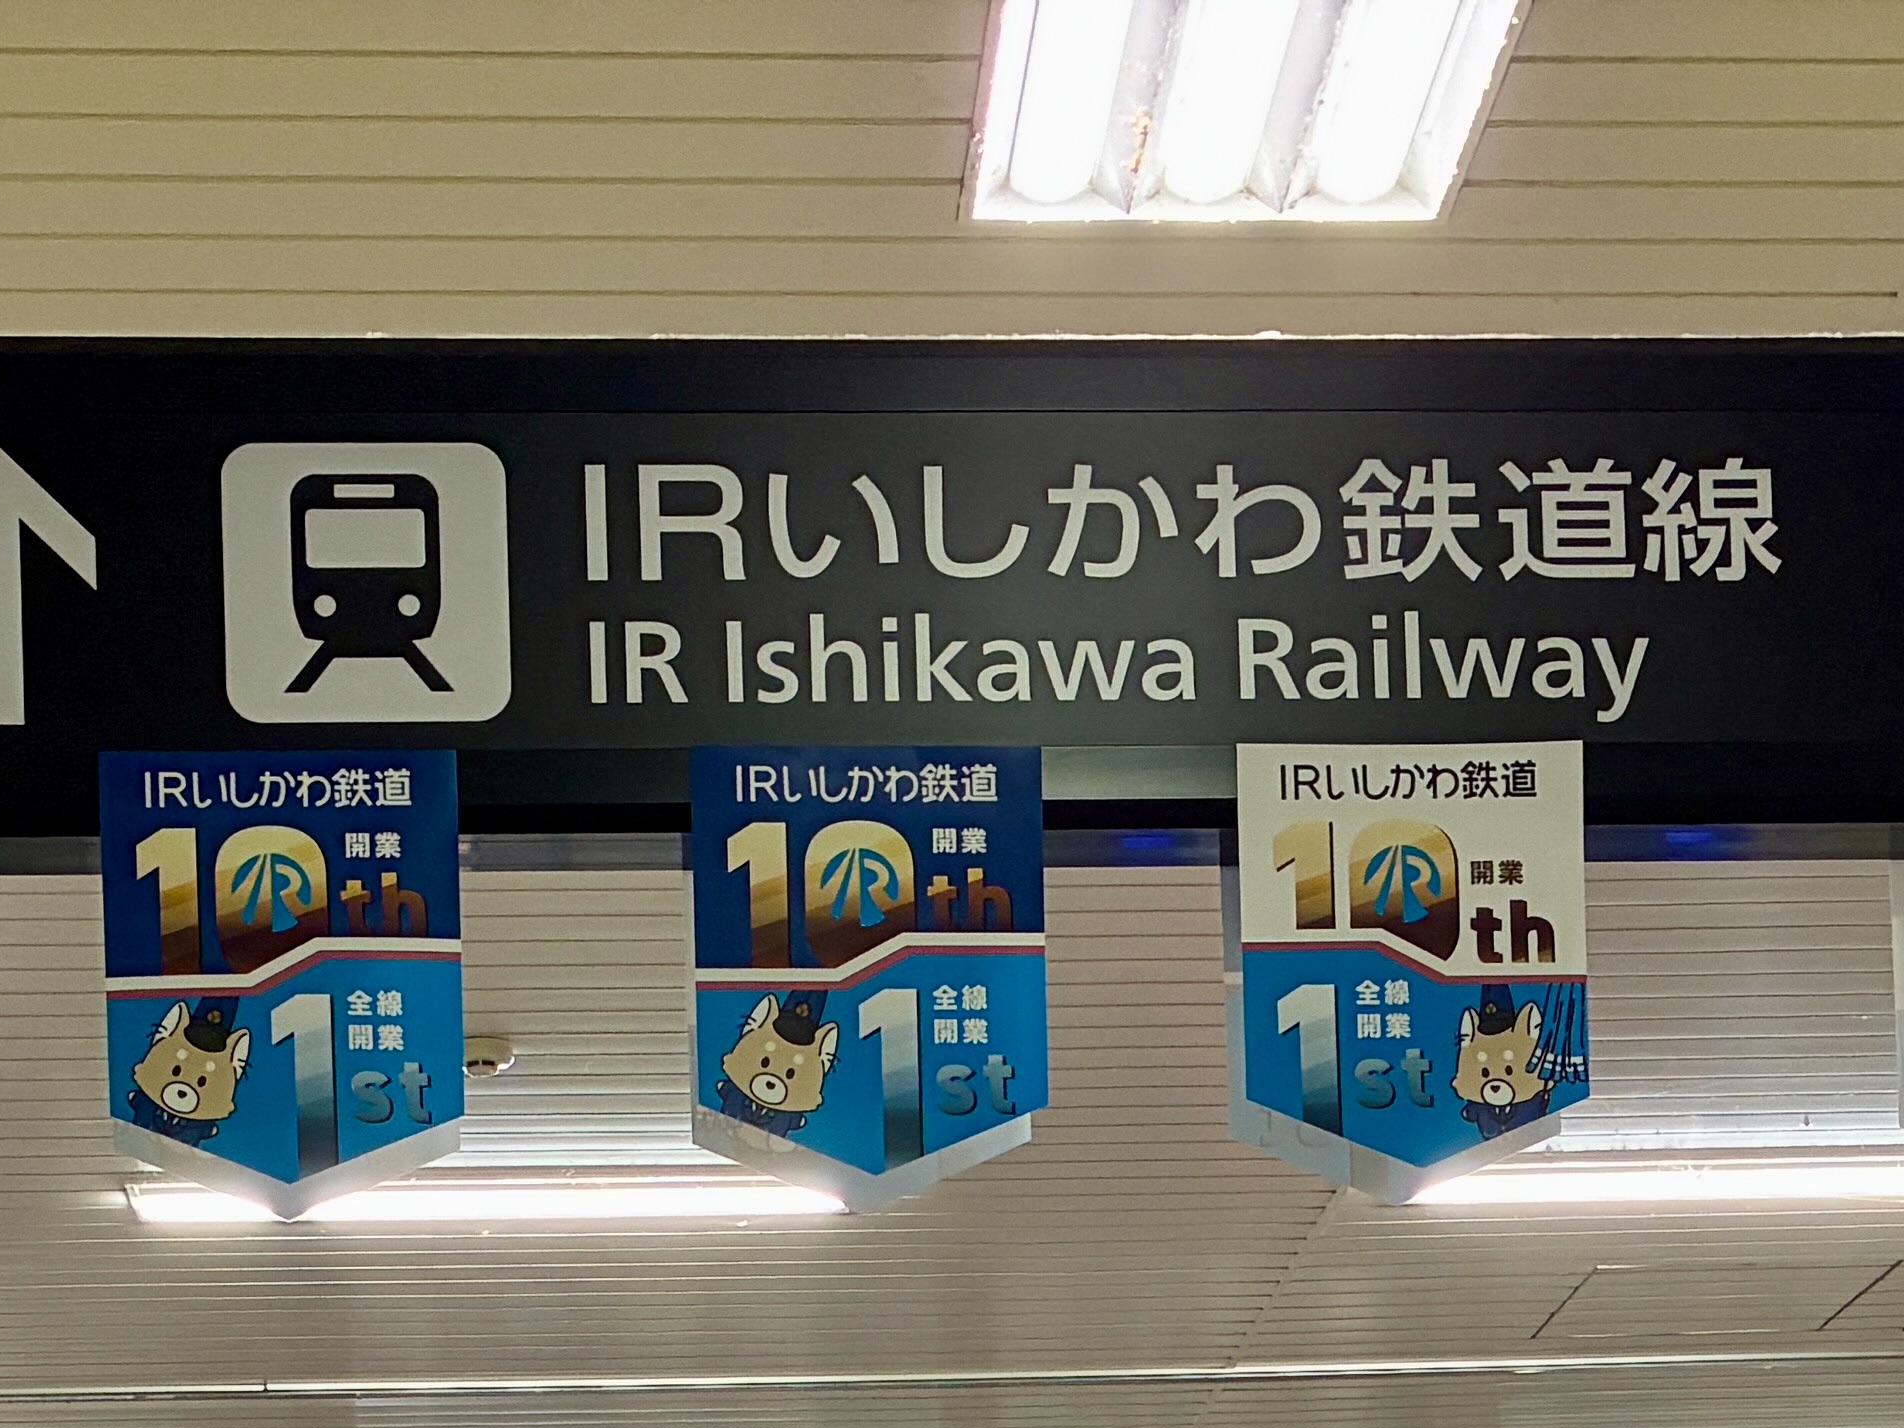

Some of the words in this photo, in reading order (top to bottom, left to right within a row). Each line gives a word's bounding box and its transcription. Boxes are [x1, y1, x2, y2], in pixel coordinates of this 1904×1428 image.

[584, 458, 1782, 582] IRいしかわ鉄道線
[587, 619, 688, 703] IR
[726, 612, 1196, 703] Ishikawa
[1236, 611, 1650, 721] Railway
[145, 769, 412, 809] IRいしかわ鉄道
[737, 763, 998, 802] IRいしかわ鉄道
[1279, 762, 1538, 802] IRいしかわ鉄道
[933, 828, 988, 854] 開業
